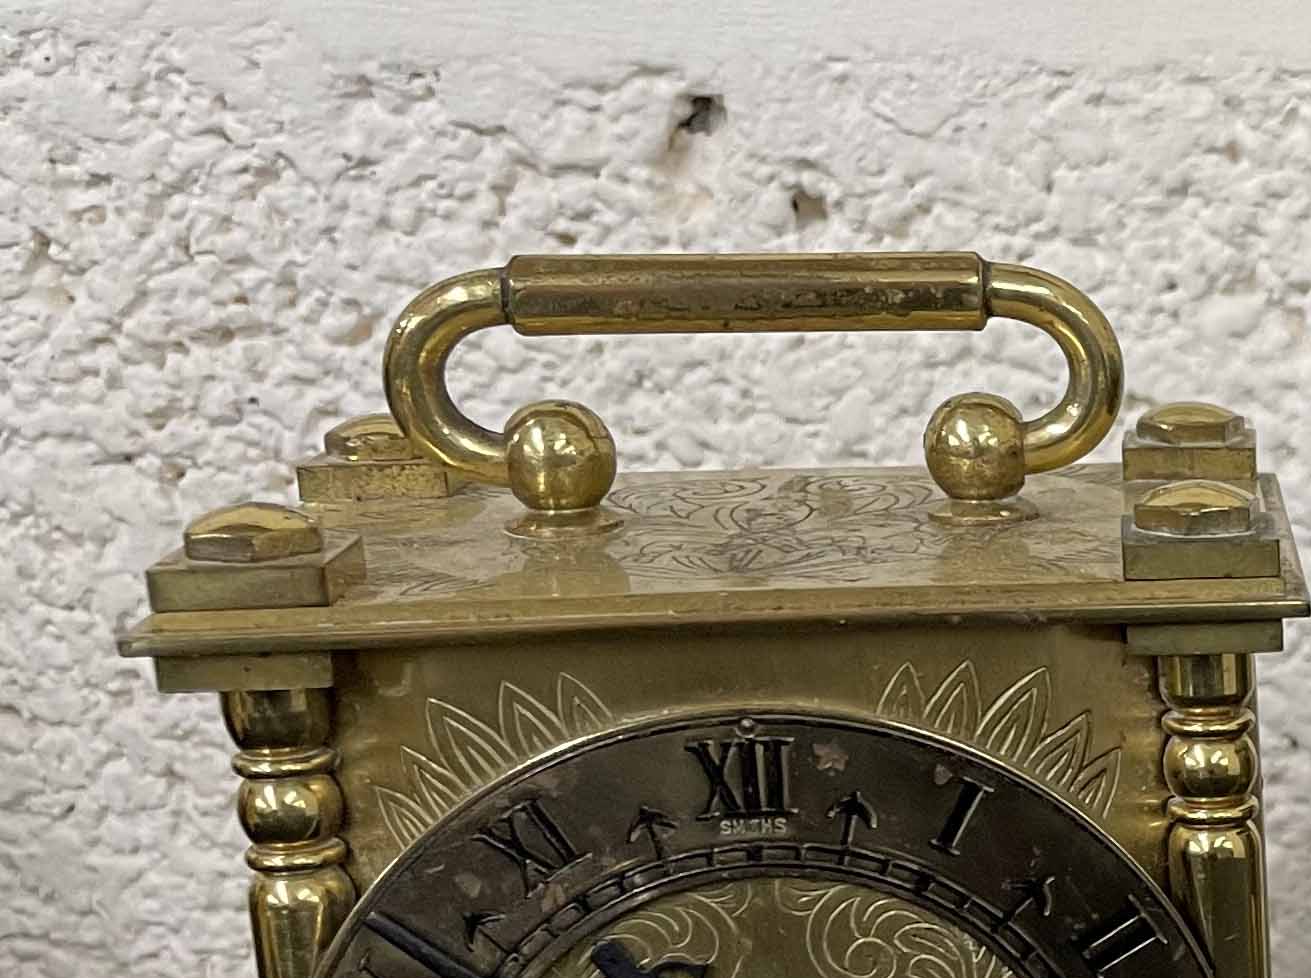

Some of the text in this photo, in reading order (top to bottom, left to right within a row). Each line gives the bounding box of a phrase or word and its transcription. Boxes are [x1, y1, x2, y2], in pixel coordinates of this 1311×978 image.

[685, 737, 798, 821] XII
[930, 776, 994, 855] I
[471, 796, 592, 898] XI
